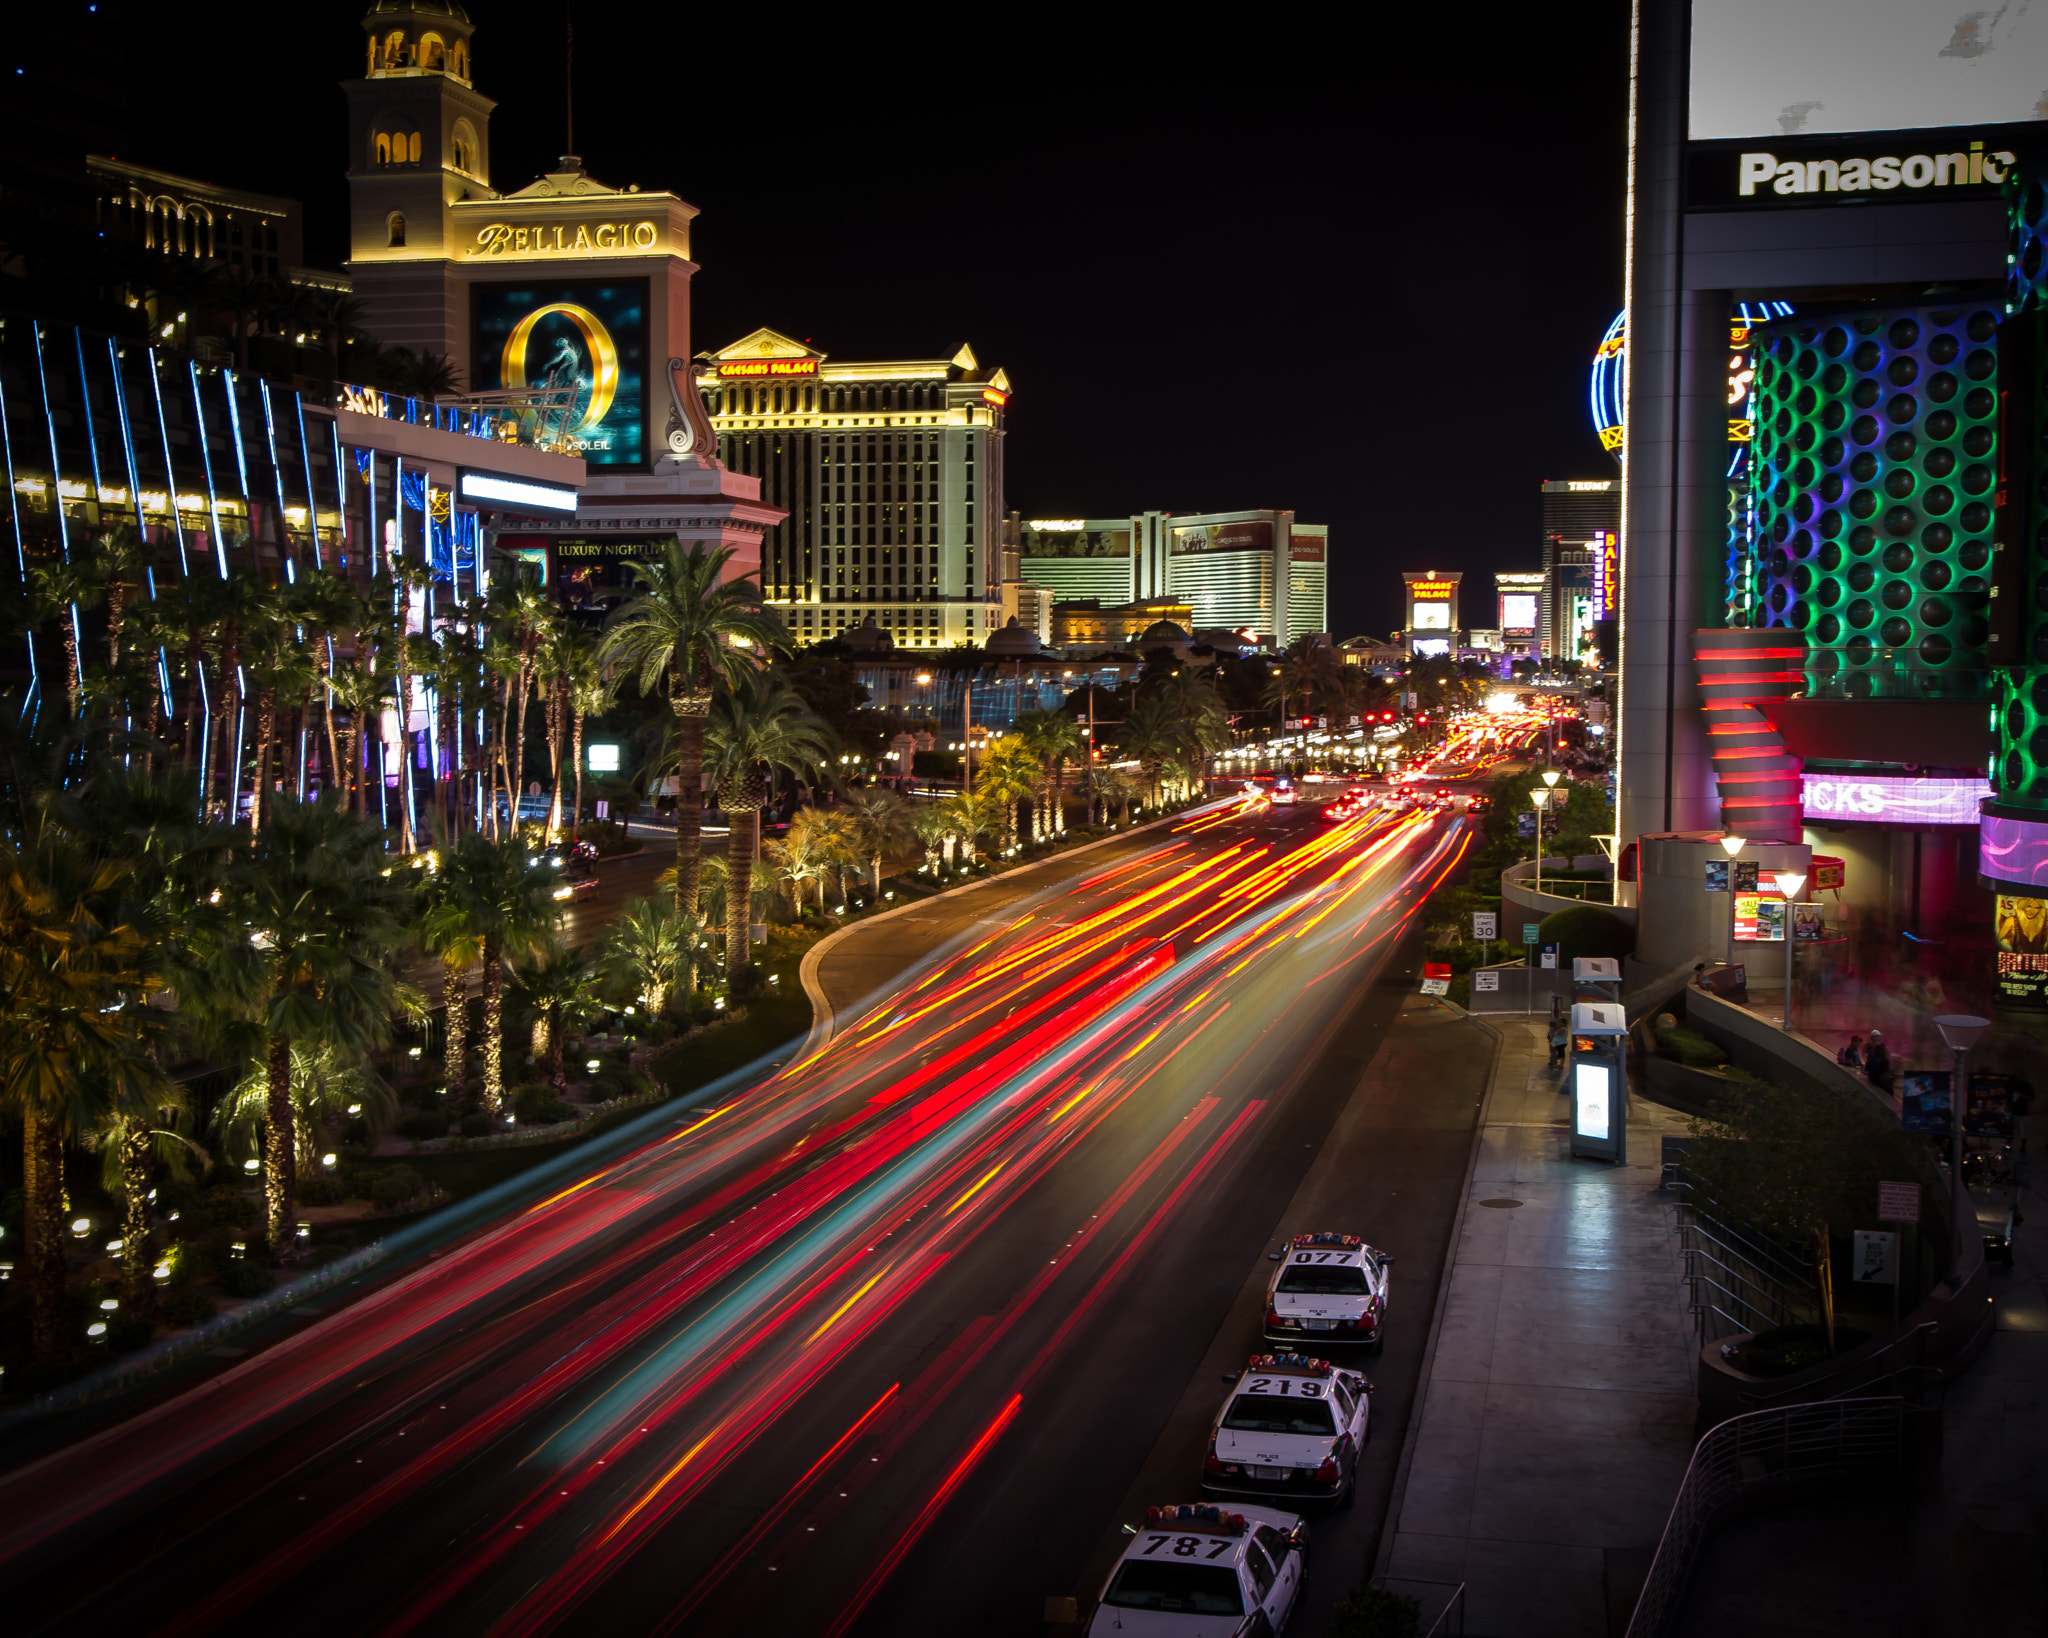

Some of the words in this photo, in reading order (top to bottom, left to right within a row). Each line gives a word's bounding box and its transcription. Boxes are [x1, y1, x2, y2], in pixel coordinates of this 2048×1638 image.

[1739, 141, 2016, 196] Panasonic
[466, 223, 658, 256] BELLAGIO
[720, 365, 769, 376] CAESARS
[771, 362, 815, 374] PALACE
[572, 440, 612, 451] SOLEIL
[1568, 481, 1611, 491] TRUMP
[558, 545, 602, 556] LUXURY
[1412, 582, 1452, 590] CAESARS
[1414, 590, 1450, 598] PALACE
[1476, 927, 1494, 936] 30
[1295, 1252, 1353, 1265] 077
[1248, 1378, 1321, 1397] 219
[1143, 1535, 1233, 1560] 787
